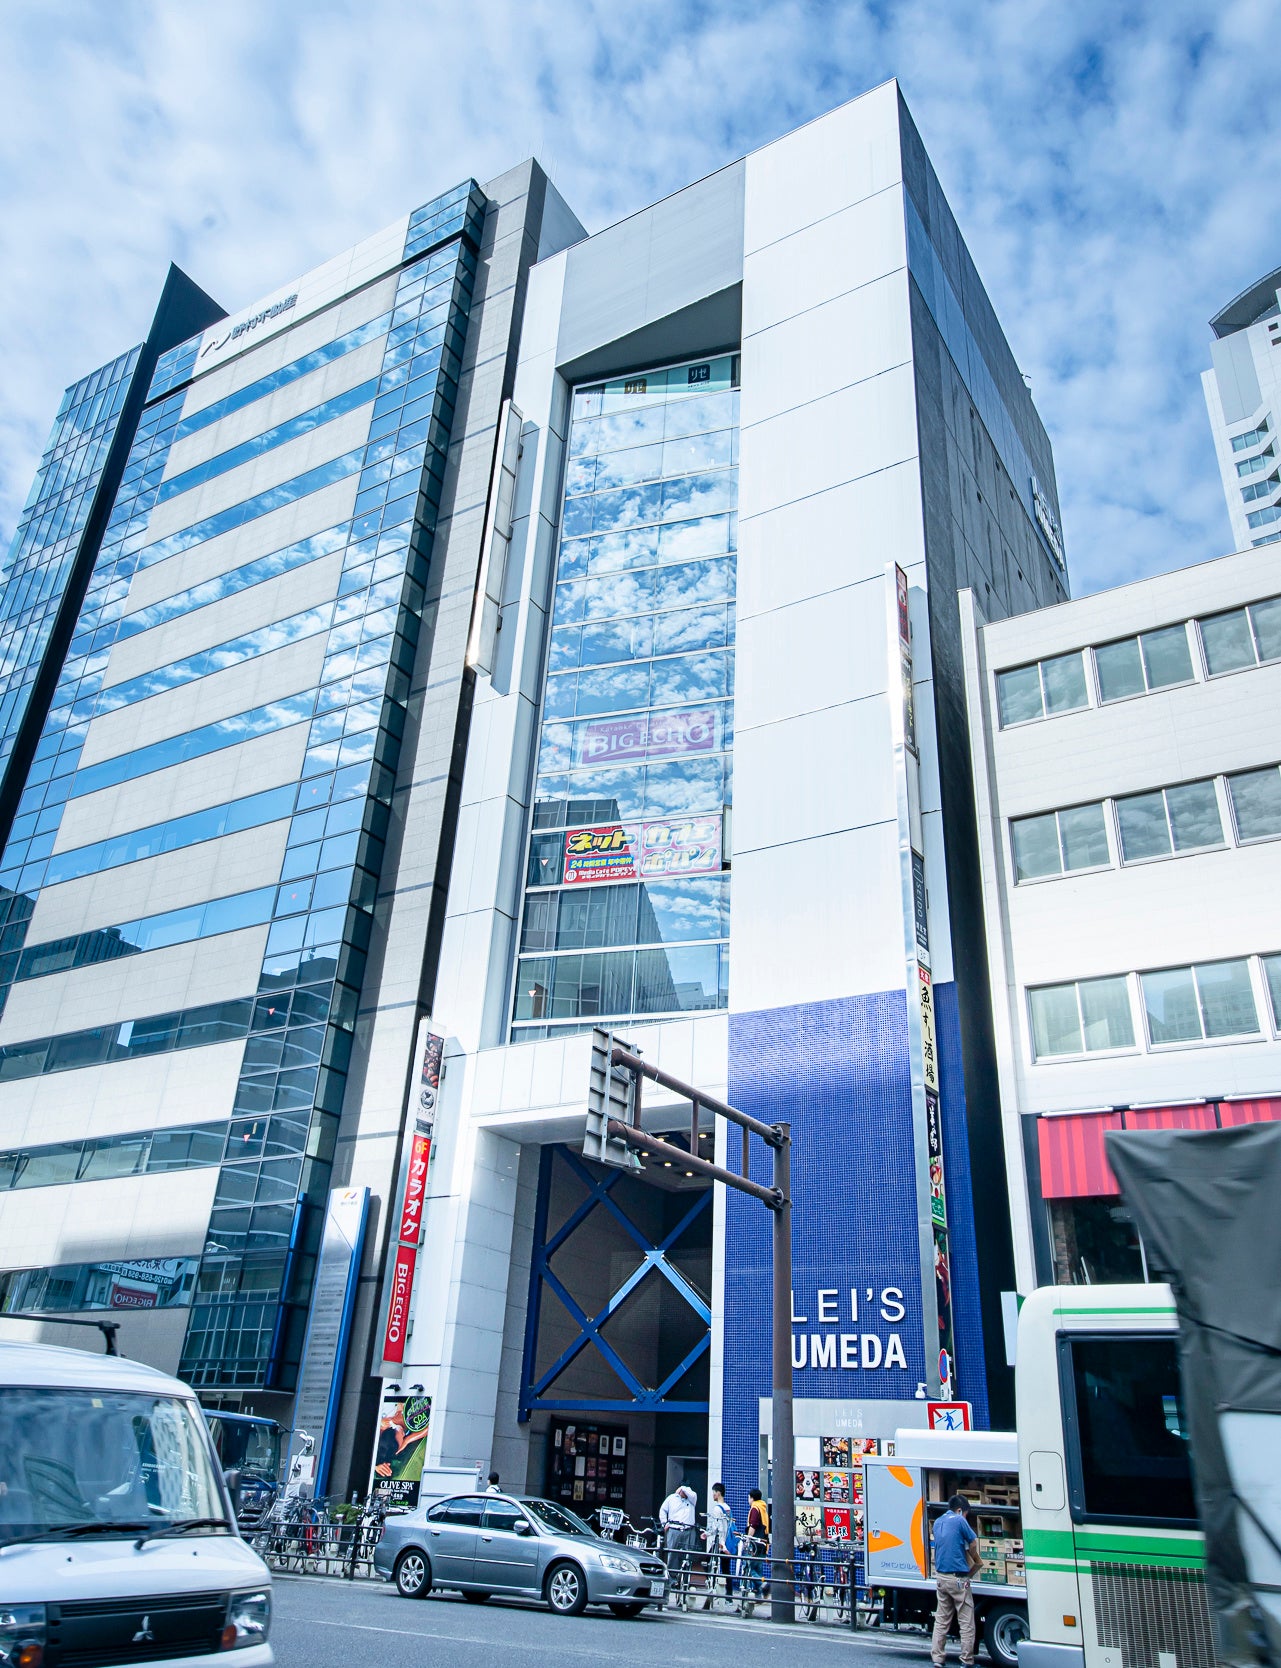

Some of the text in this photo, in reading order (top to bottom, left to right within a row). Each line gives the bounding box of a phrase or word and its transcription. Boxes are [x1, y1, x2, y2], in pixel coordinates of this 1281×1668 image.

[690, 367, 707, 381] リゼ
[587, 732, 634, 757] BIG
[640, 723, 711, 746] ECHO
[567, 829, 636, 853] ネット
[645, 823, 716, 847] カフェ
[642, 847, 718, 873] ポパイ
[414, 1142, 428, 1154] 6F
[403, 1158, 426, 1236] カラオケ
[388, 1263, 409, 1342] BIG ECHO
[791, 1287, 906, 1322] LEI'S
[791, 1333, 908, 1369] UMEDA
[835, 1418, 863, 1428] UMEDA
[380, 1480, 401, 1490] OLIVE
[401, 1481, 414, 1491] SPA
